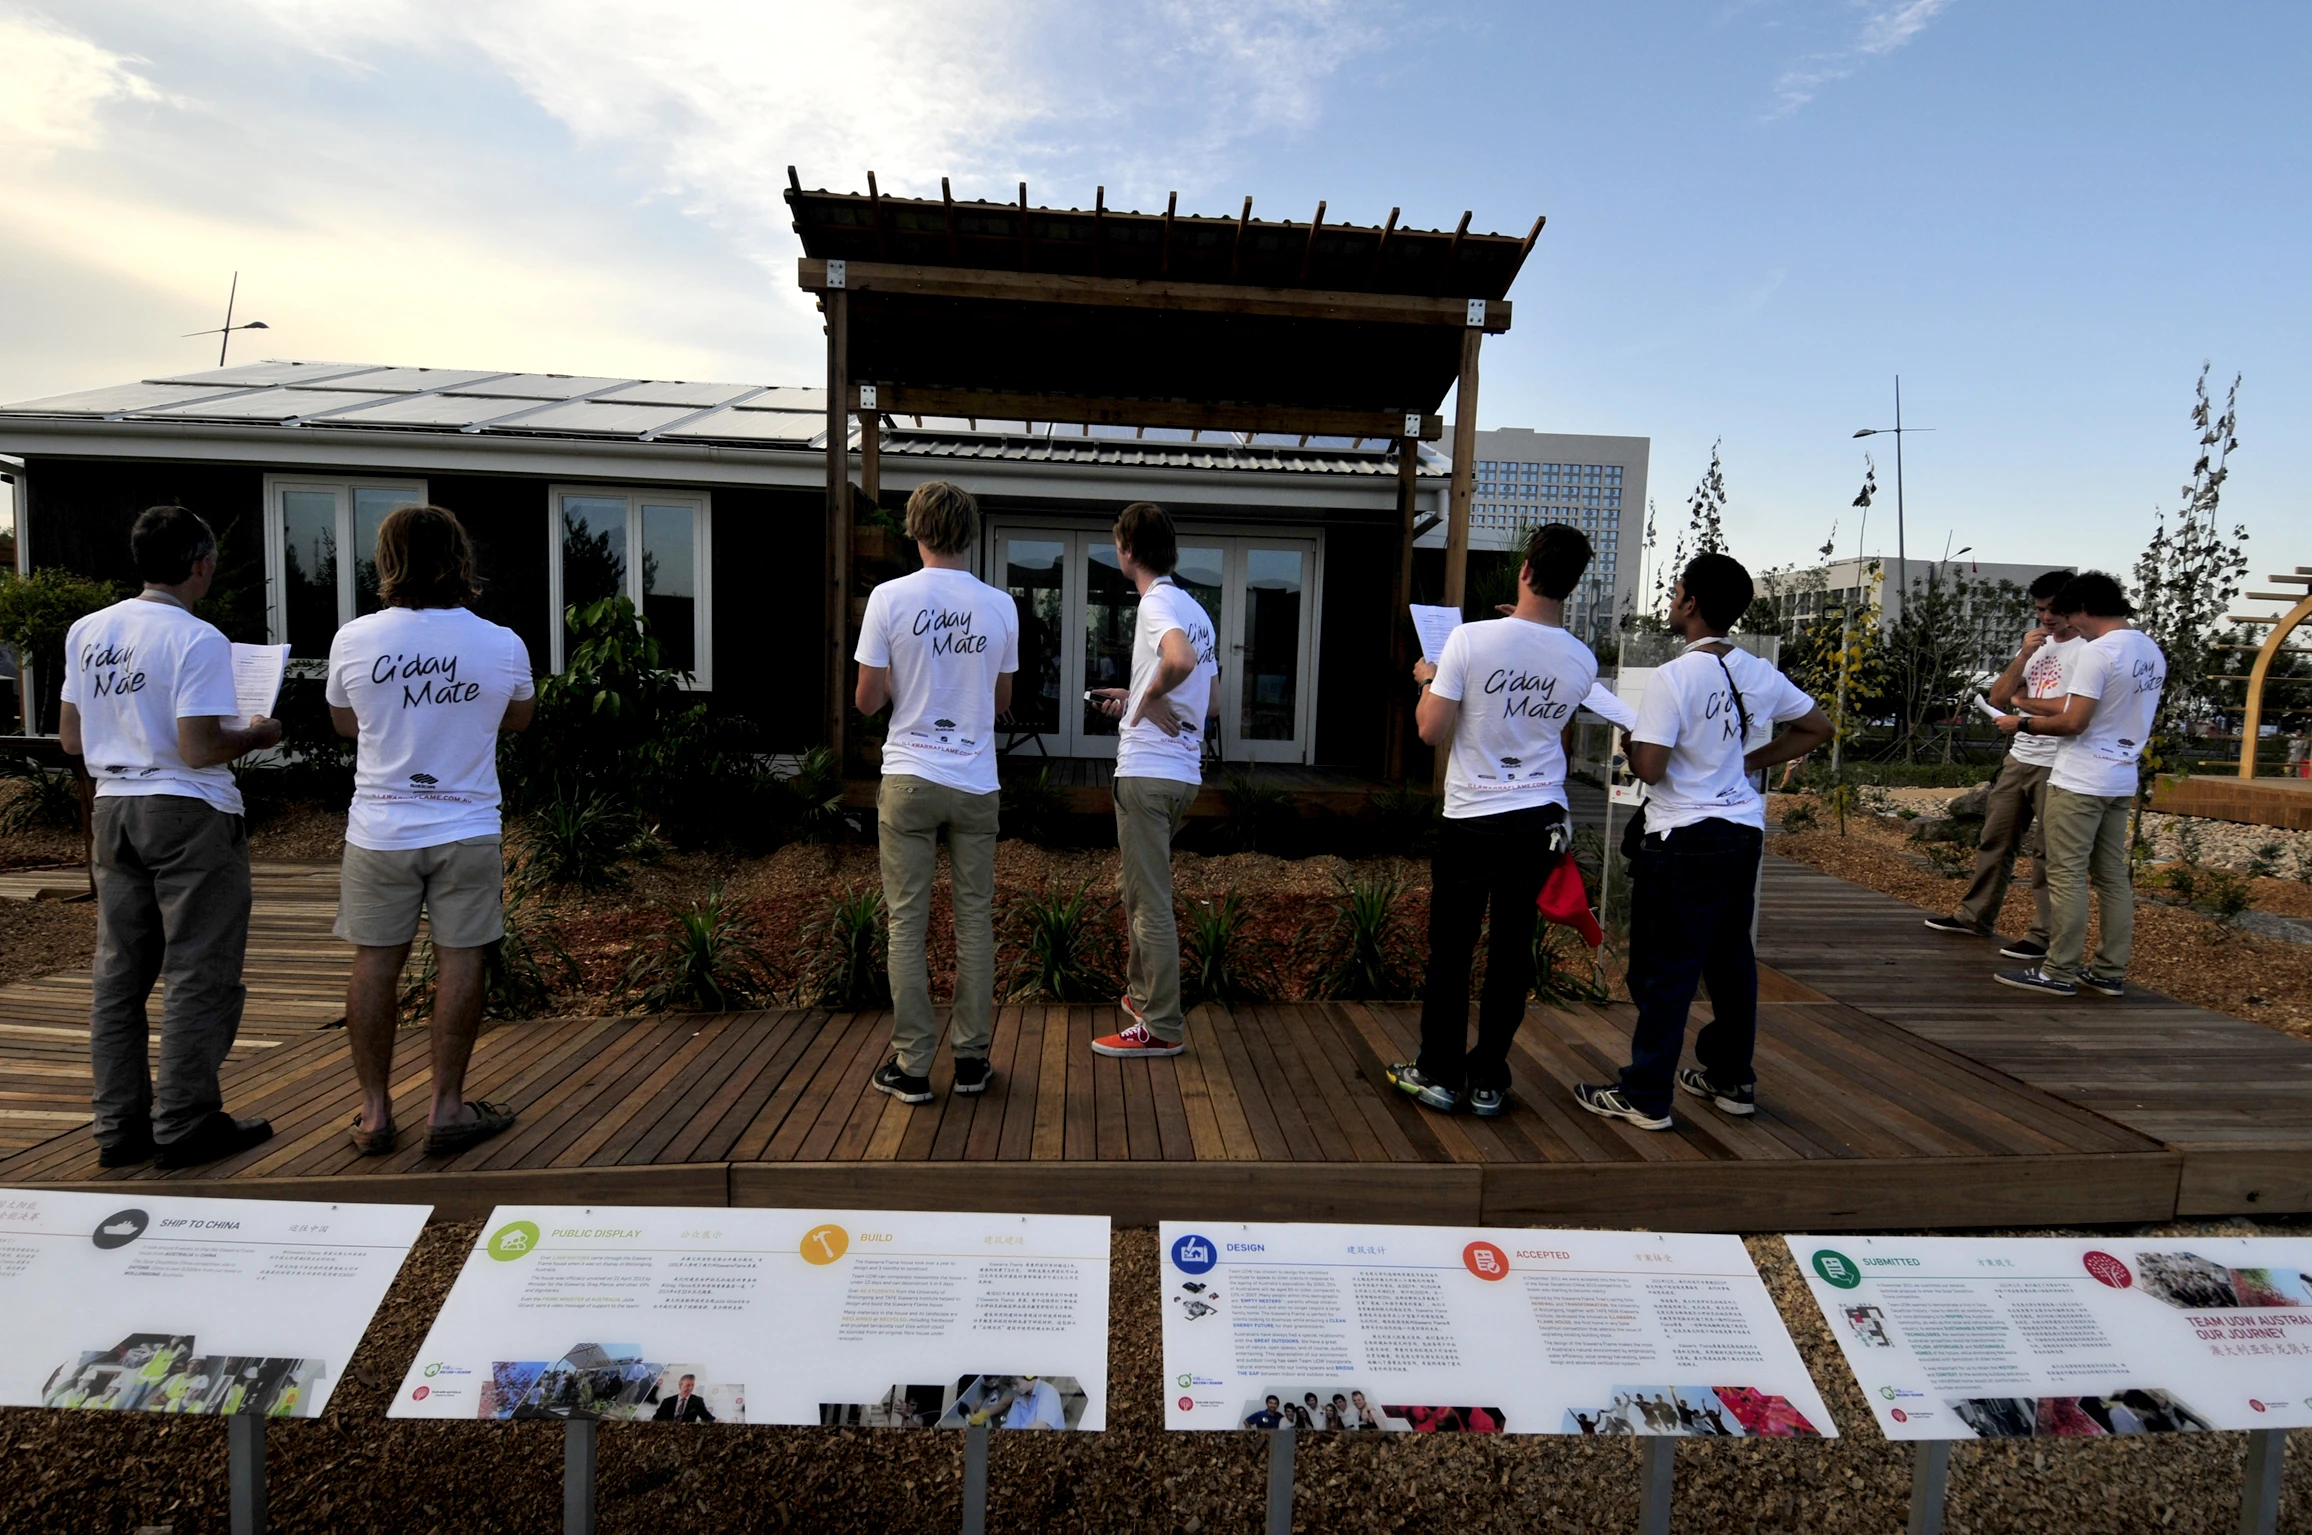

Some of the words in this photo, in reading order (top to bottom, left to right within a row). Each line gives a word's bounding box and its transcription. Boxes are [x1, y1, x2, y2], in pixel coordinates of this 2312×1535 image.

[913, 608, 972, 636] G'day
[932, 632, 987, 658] Mate
[372, 652, 457, 684] G'day
[1484, 669, 1557, 701] G'day
[403, 680, 480, 709] Mate
[1503, 695, 1568, 720] Mate
[159, 1219, 187, 1228] SHIP
[190, 1220, 204, 1229] TO
[205, 1221, 240, 1230] CHINA
[551, 1229, 593, 1238] PUBLIC
[594, 1230, 642, 1239] DISPLAY
[860, 1233, 893, 1242] BUILD
[1226, 1243, 1265, 1252] DESIGN
[1516, 1250, 1570, 1259] ACCEPTED
[1862, 1258, 1920, 1266] SUBMITTED
[2184, 1317, 2225, 1327] TEAM
[2223, 1316, 2256, 1327] UOW
[2195, 1329, 2226, 1340] OUR
[2228, 1328, 2287, 1339] JOURNEY
